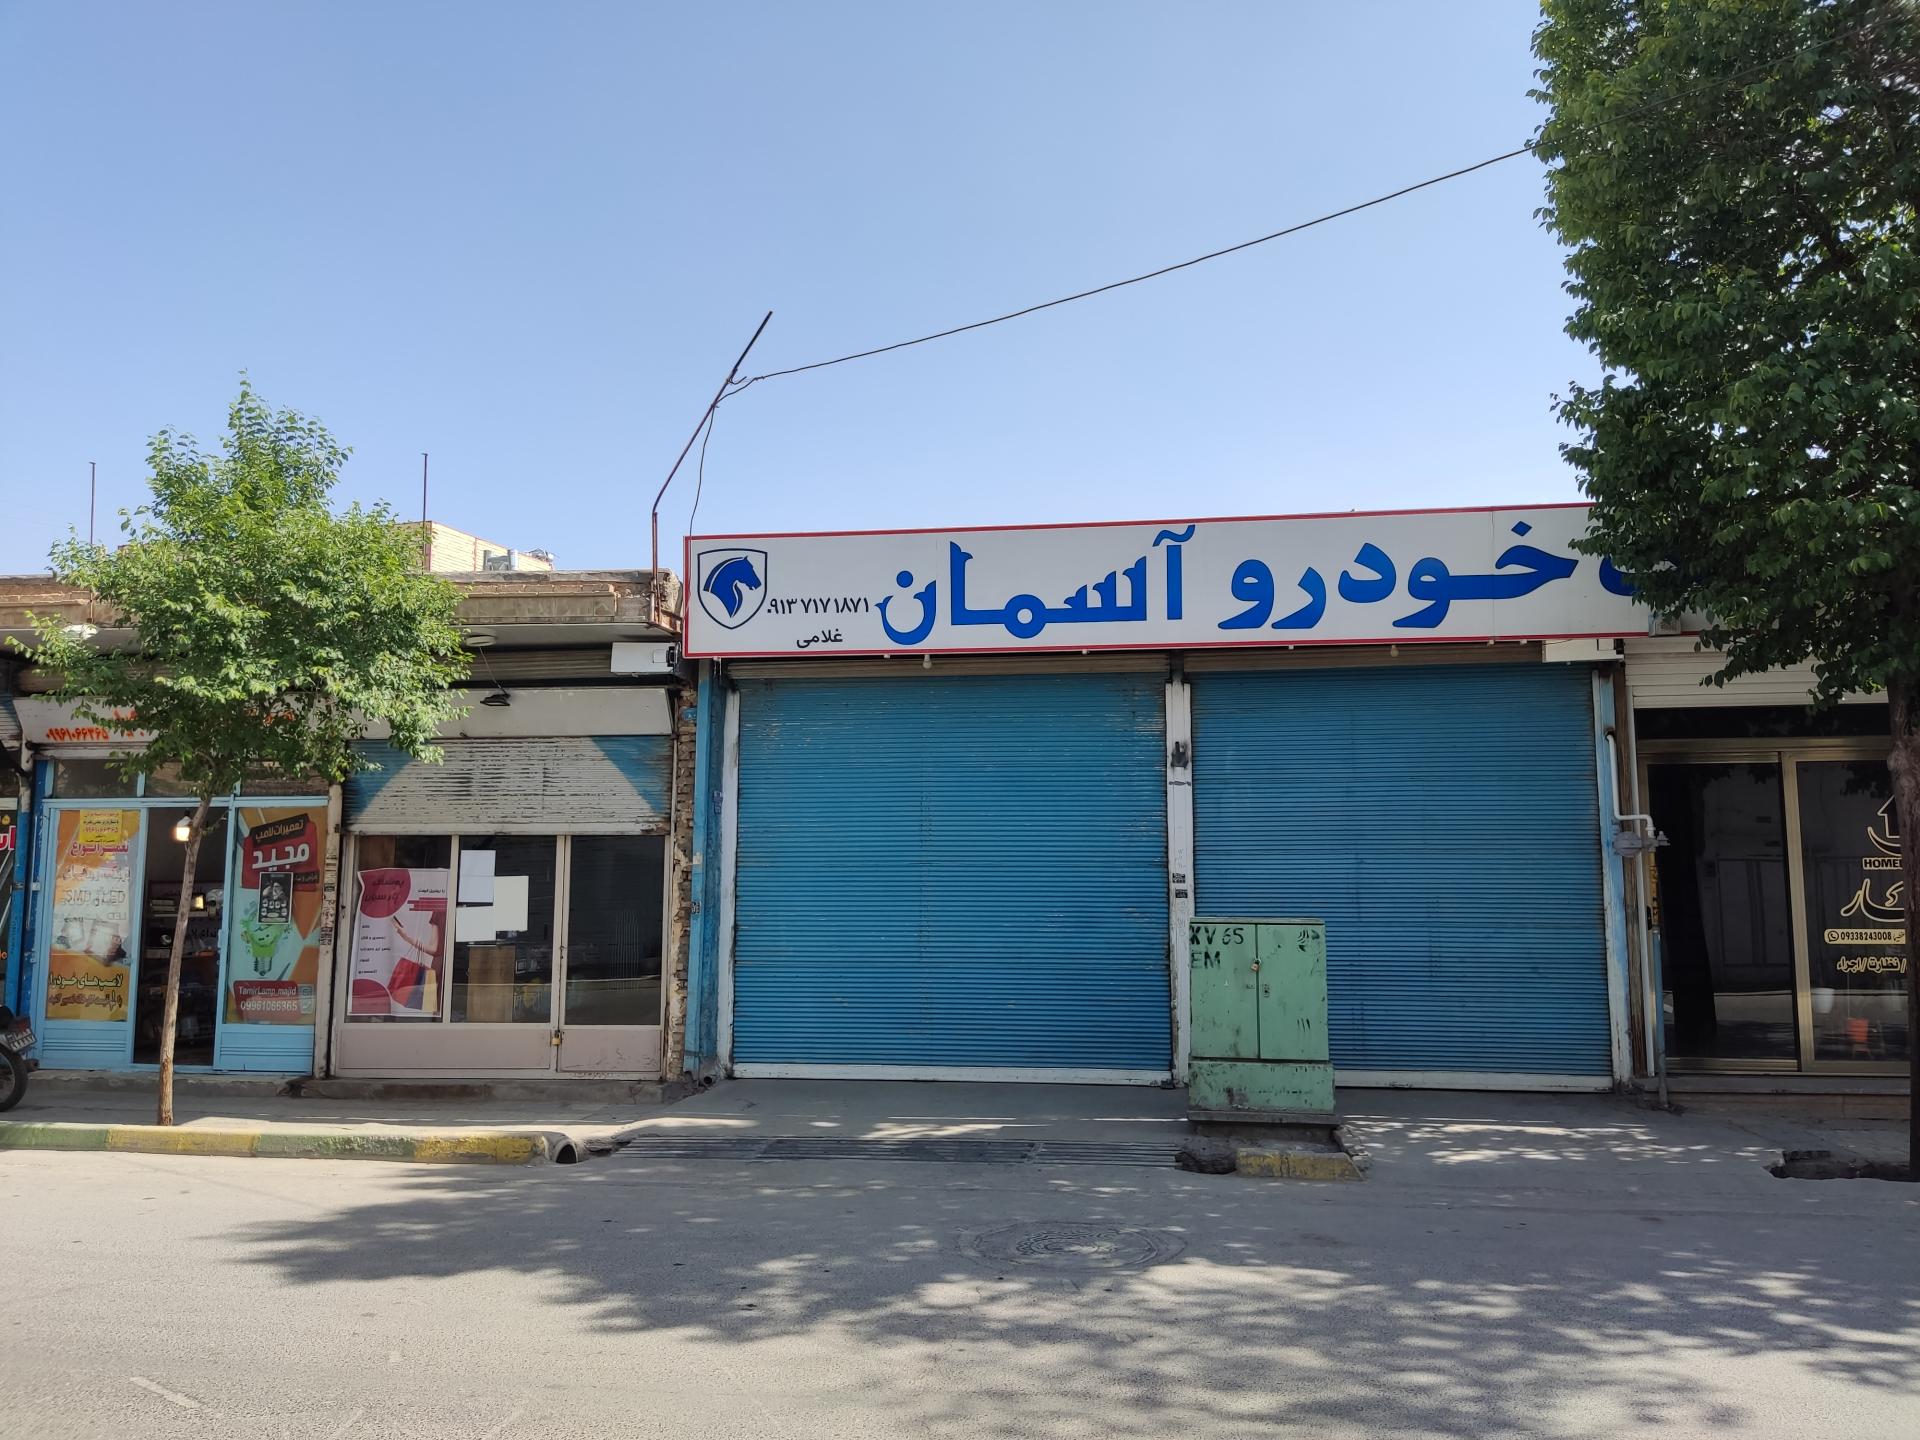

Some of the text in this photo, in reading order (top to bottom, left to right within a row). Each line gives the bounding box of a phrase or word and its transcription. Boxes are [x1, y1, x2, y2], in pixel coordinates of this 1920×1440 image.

[875, 520, 1579, 645] خودرو آسمان
[796, 628, 843, 648] غلامی
[252, 843, 310, 872] مجید
[1863, 859, 1903, 868] HOME
[1840, 931, 1892, 941] 09338243008
[240, 1000, 298, 1011] 09961066365
